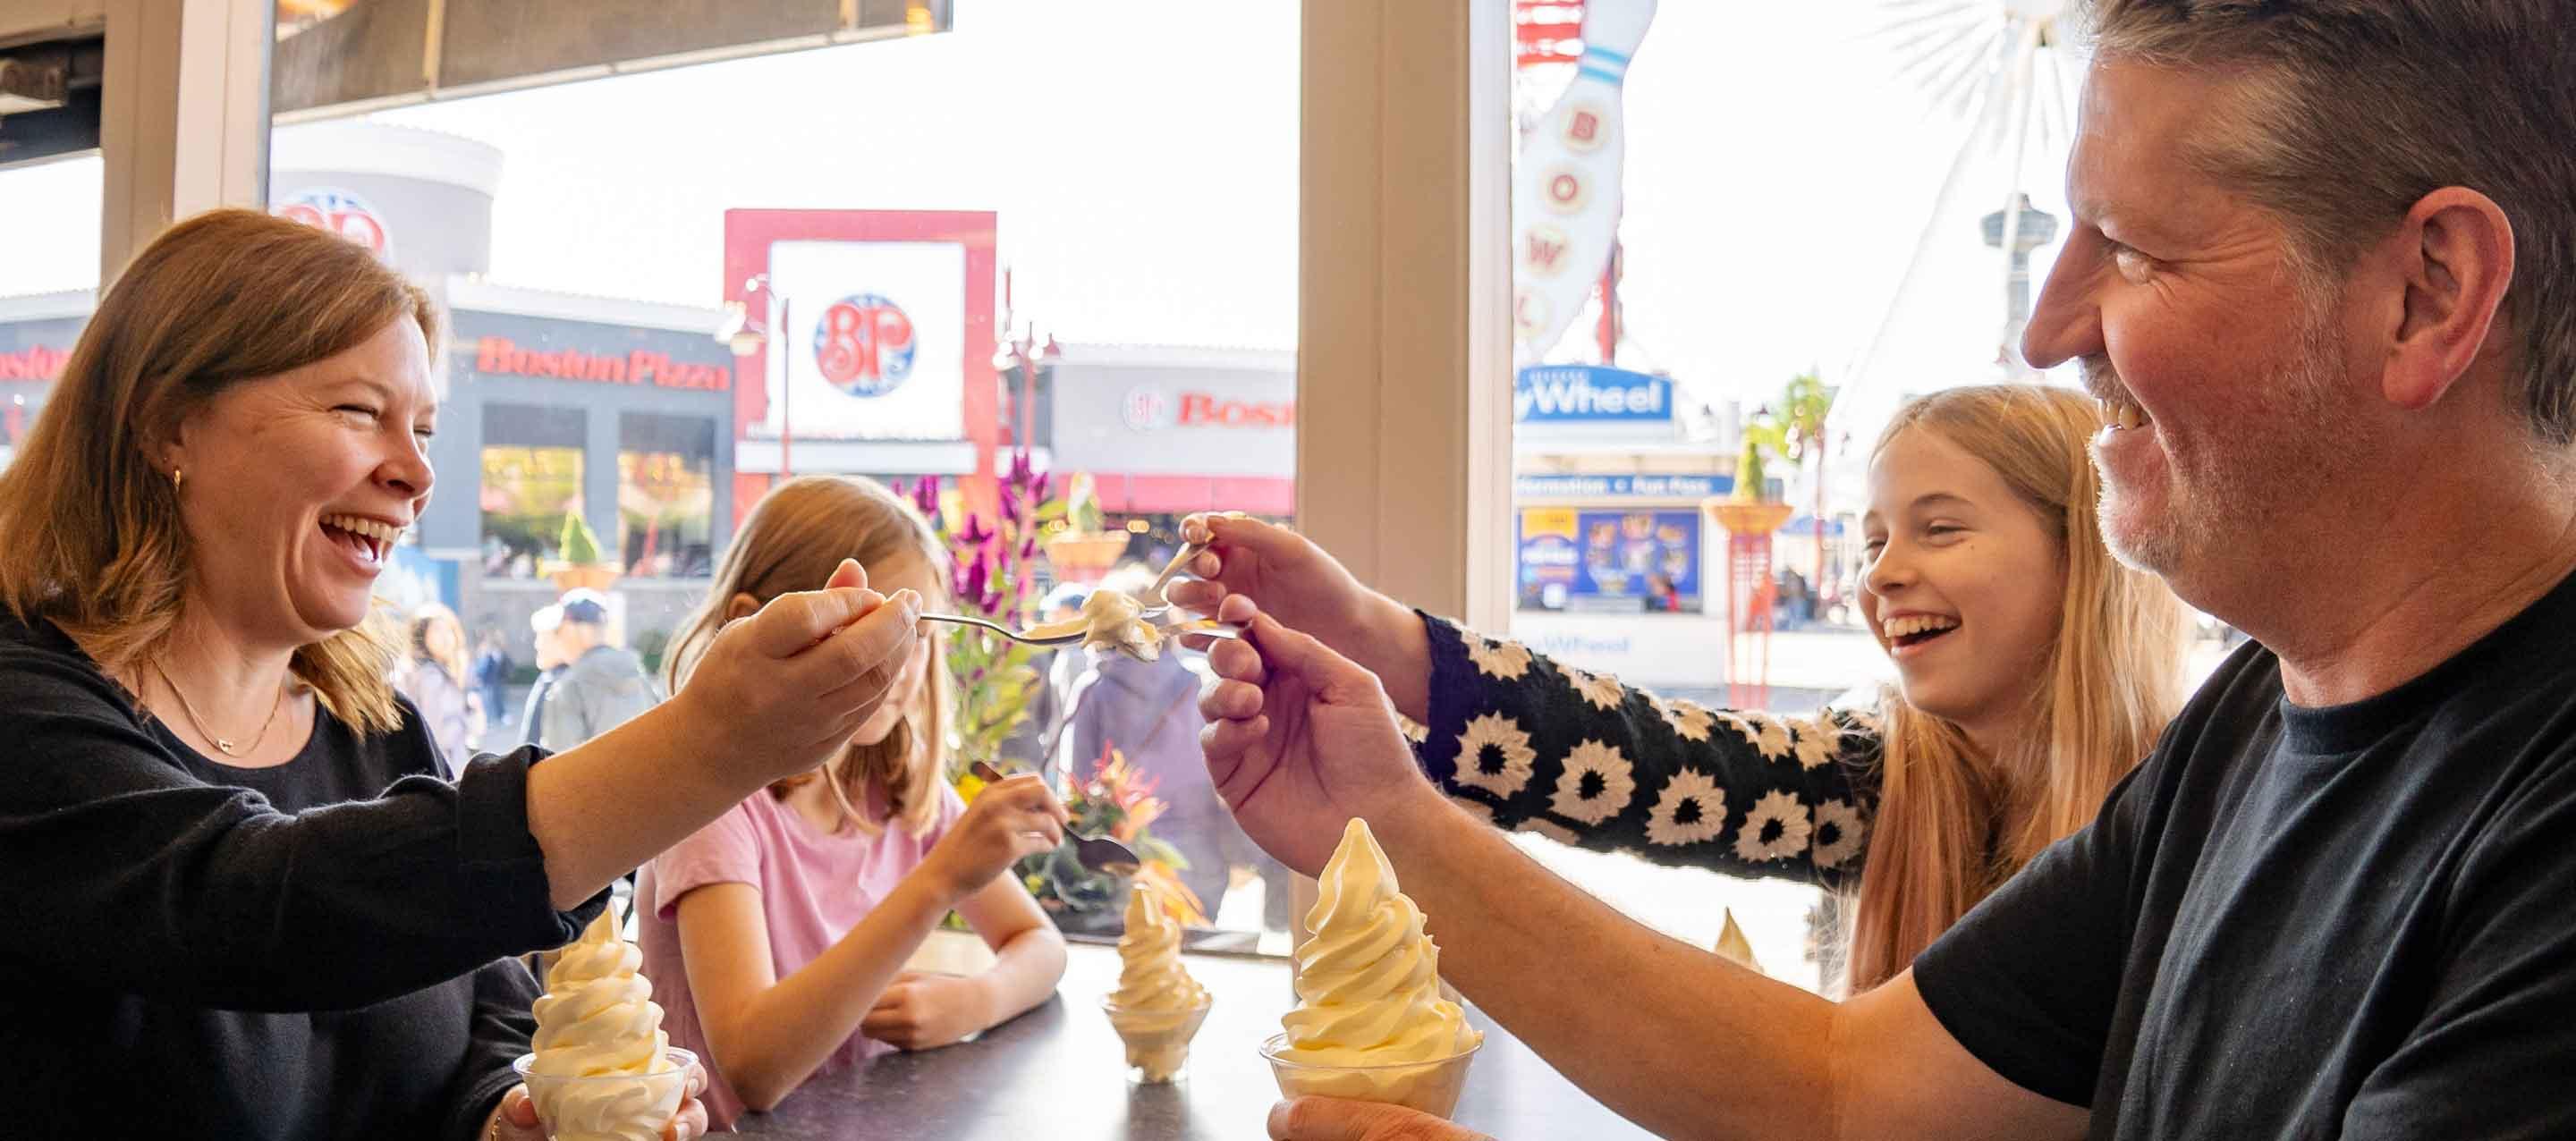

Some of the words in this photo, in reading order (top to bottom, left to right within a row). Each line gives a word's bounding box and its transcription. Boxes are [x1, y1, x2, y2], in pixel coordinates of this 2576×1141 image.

[476, 336, 627, 383] Boston
[628, 350, 731, 391] Pizza
[818, 302, 914, 384] BP
